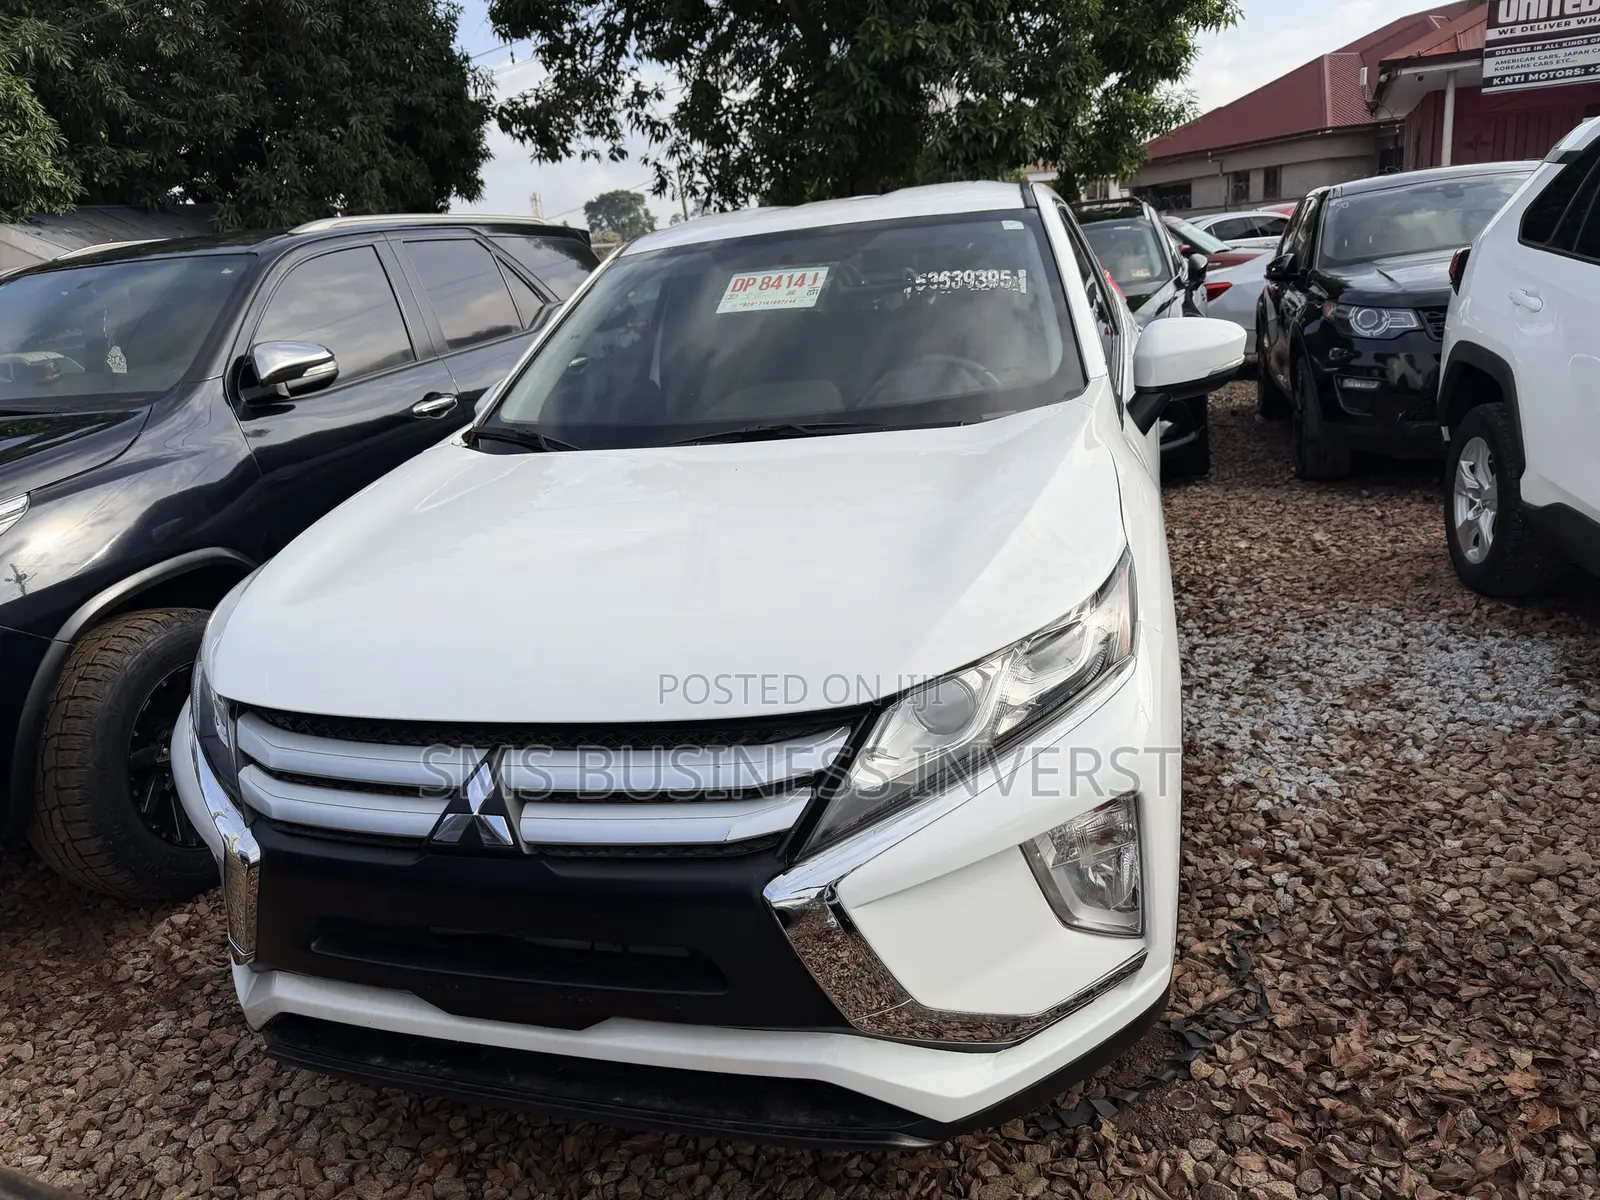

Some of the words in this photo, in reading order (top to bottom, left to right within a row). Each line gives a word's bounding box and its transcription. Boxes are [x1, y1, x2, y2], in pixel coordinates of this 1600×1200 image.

[1521, 20, 1571, 32] DELIVER
[1495, 46, 1532, 56] DEALERS
[1562, 39, 1588, 47] KINDS
[1494, 56, 1535, 66] AMERICAN
[1563, 49, 1589, 58] JAPAN
[1494, 63, 1531, 72] KOREANS
[1493, 74, 1525, 85] K.NTI
[1528, 67, 1585, 81] MOTORS:
[731, 277, 757, 292] DP
